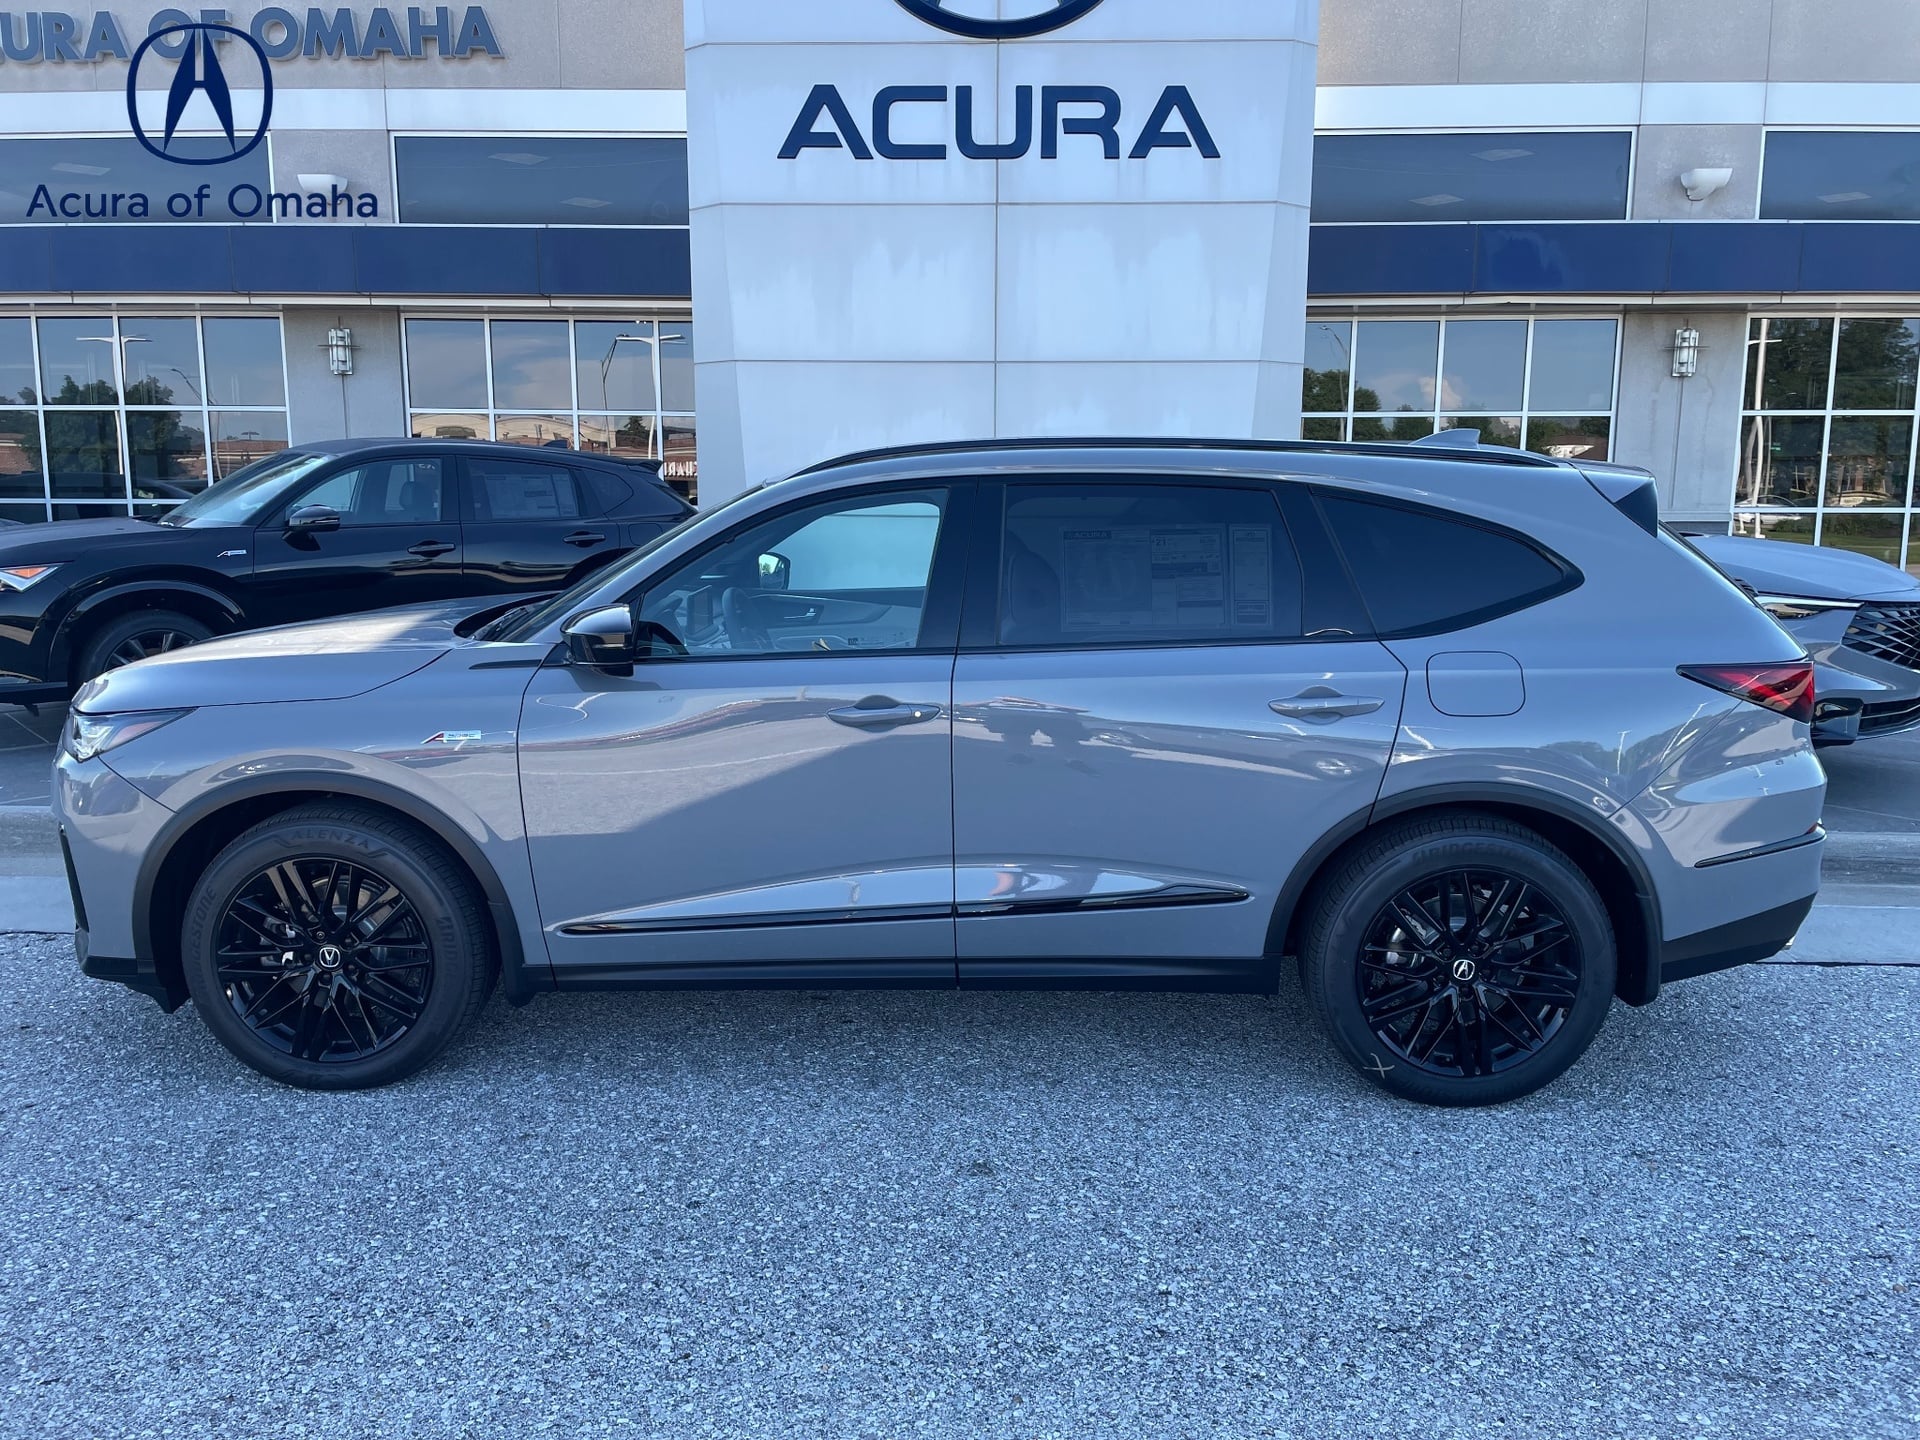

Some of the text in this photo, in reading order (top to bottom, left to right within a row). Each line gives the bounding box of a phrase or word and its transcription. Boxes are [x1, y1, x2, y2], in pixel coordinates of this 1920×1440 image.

[0, 11, 130, 63] URA
[249, 6, 505, 60] OMAHA
[777, 83, 1222, 161] ACURA
[290, 828, 369, 850] ALENZA
